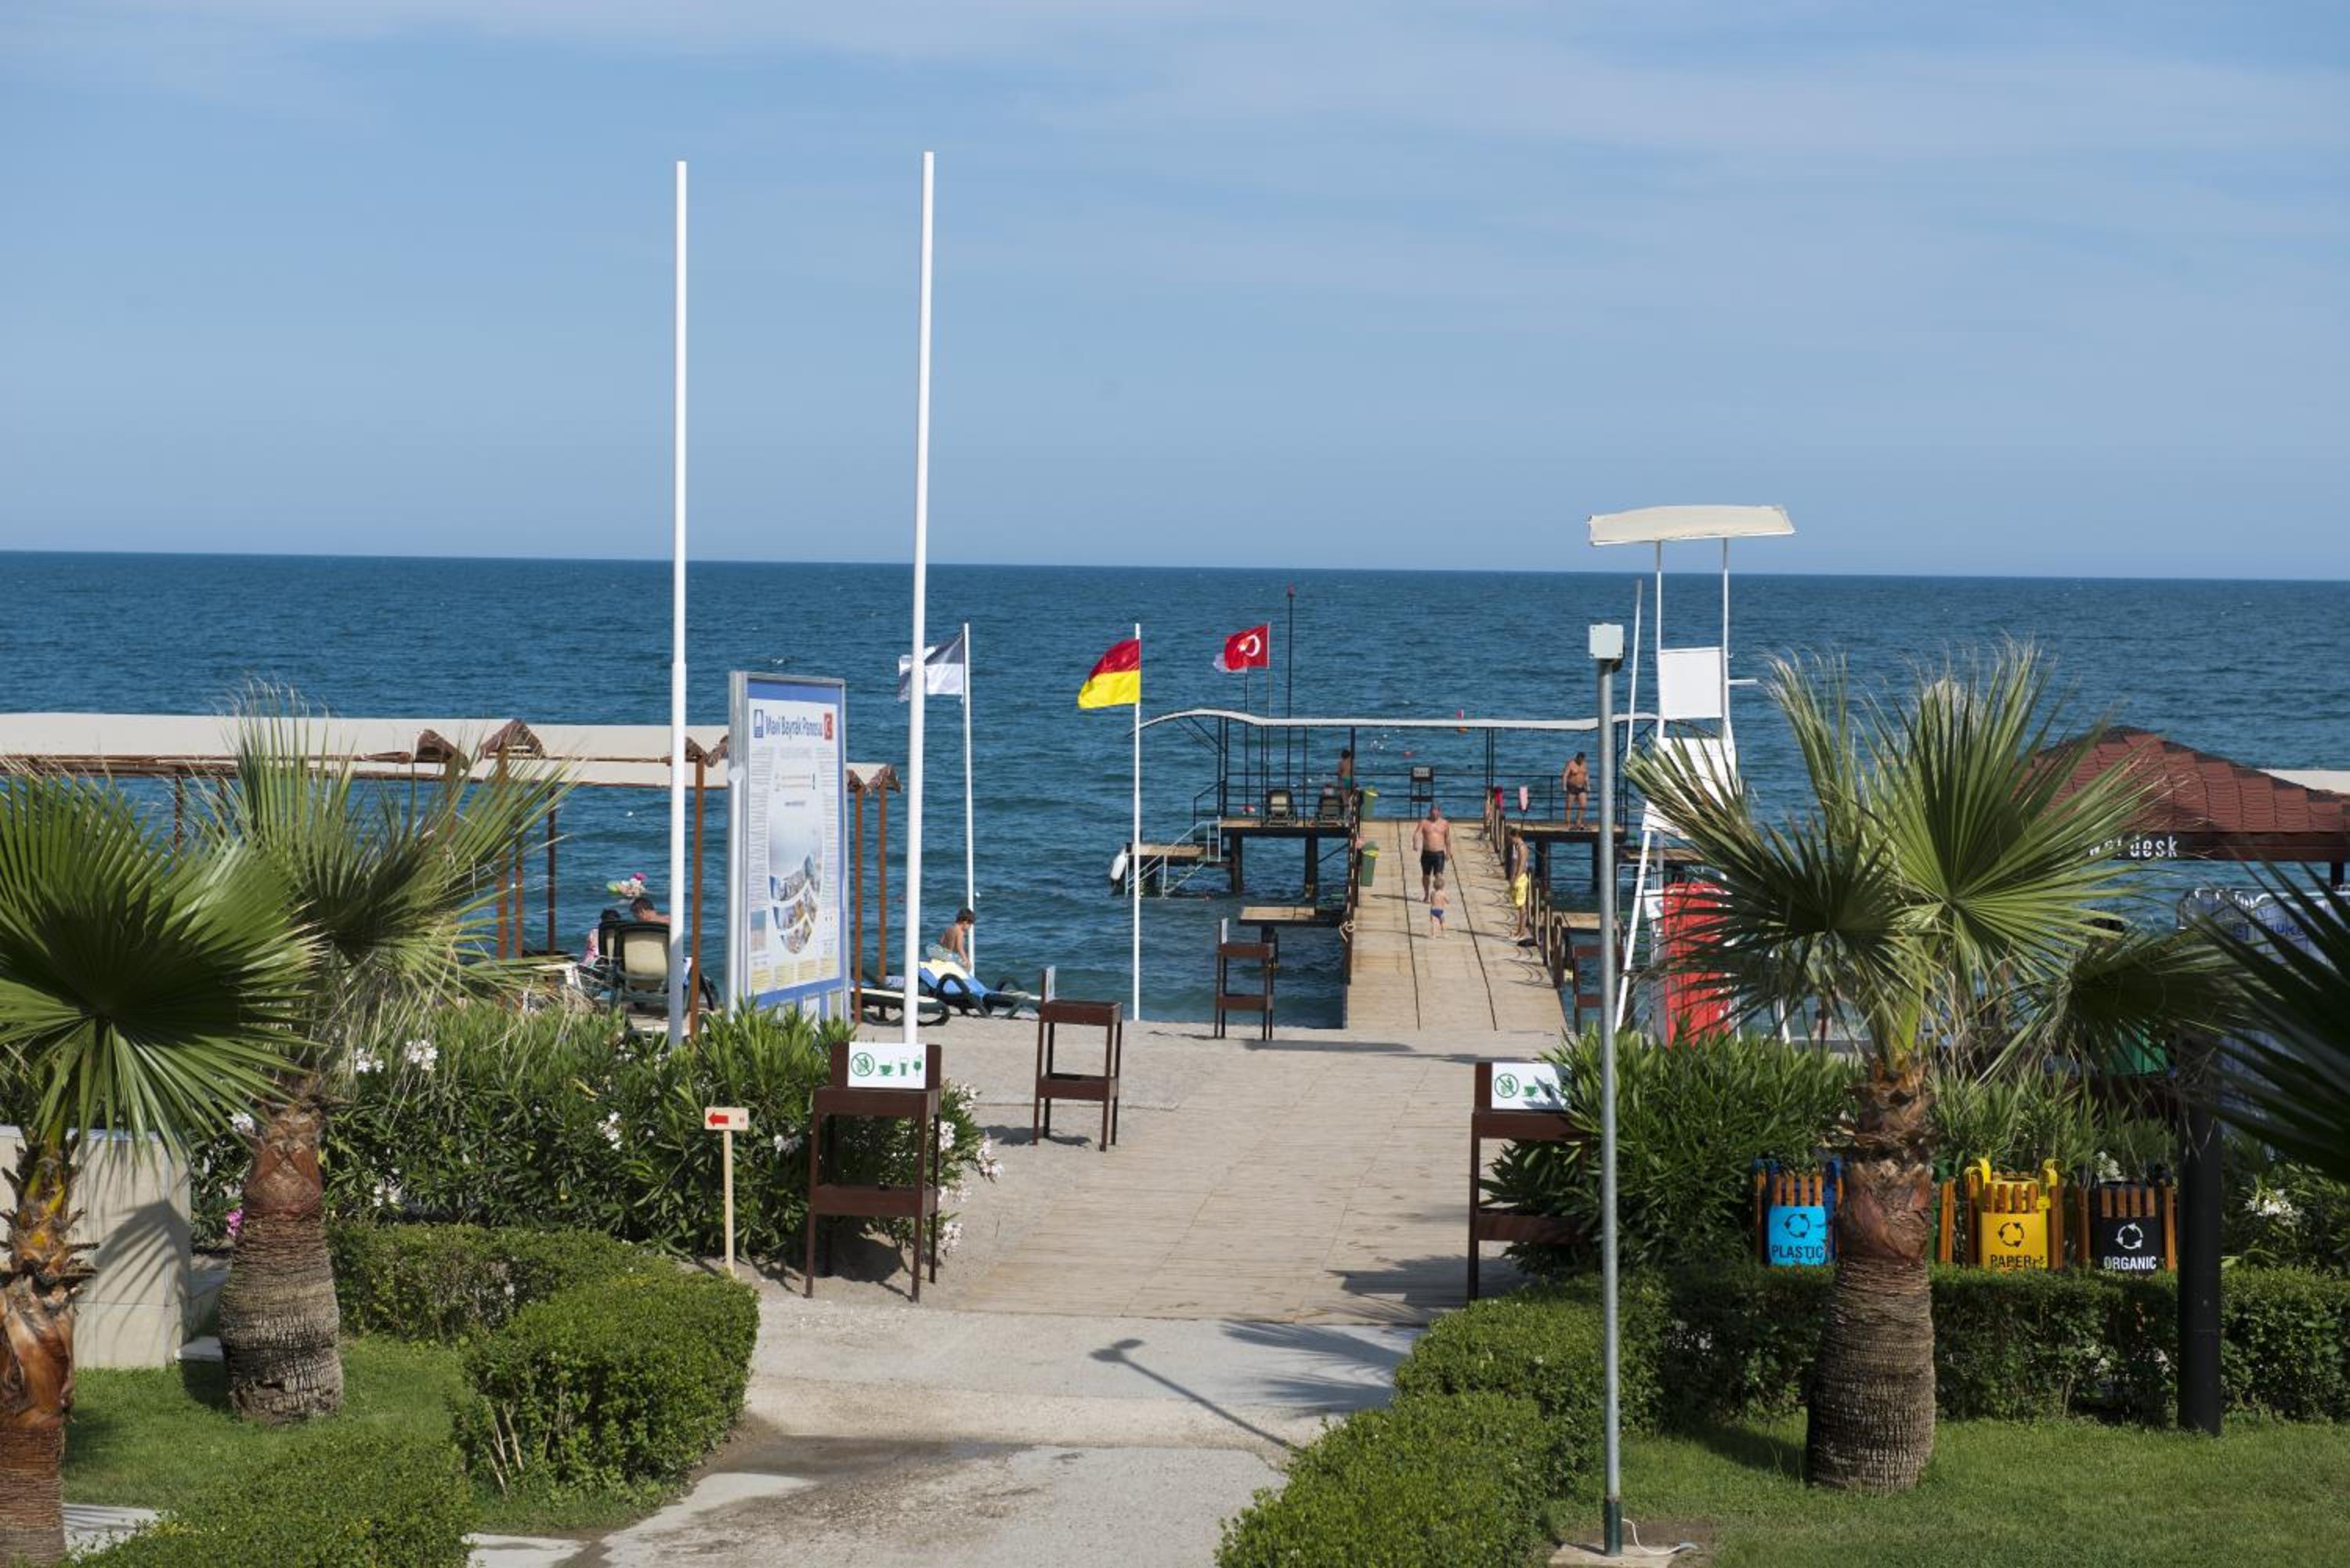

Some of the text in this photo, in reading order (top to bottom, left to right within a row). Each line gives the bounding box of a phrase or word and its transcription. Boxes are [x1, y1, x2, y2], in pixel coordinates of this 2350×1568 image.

[781, 715, 802, 740] Bayrak
[2130, 834, 2178, 858] desk
[1771, 1245, 1824, 1259] PLASTIC
[1990, 1254, 2032, 1268] PAPER
[2103, 1255, 2157, 1270] ORGANIC
